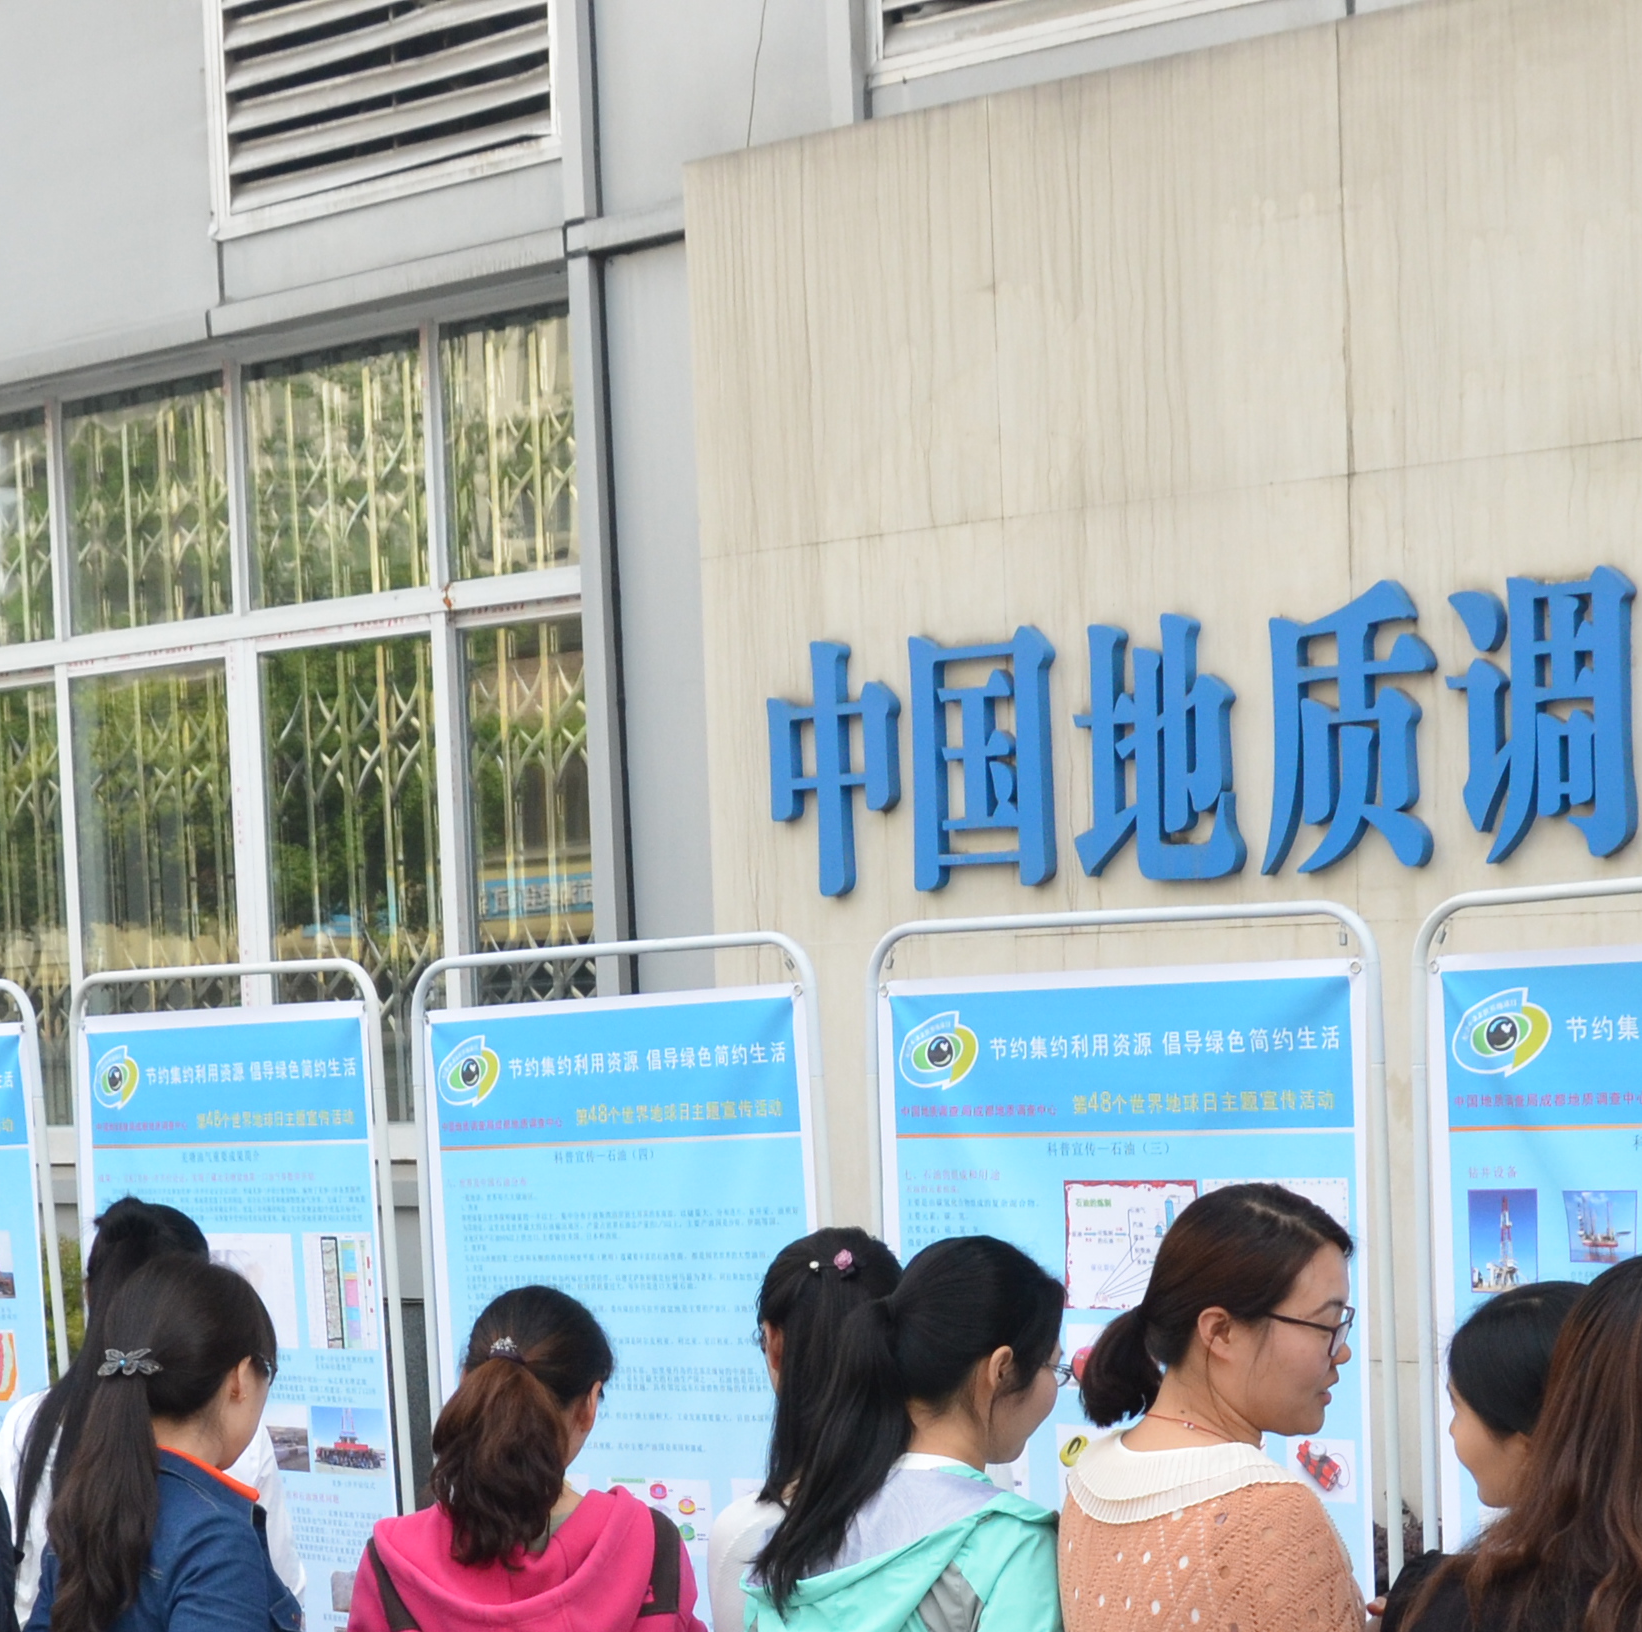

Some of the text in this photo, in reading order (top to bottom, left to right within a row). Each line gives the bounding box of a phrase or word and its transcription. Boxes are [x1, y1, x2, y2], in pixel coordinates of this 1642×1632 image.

[989, 1031, 1154, 1061] 节约集约利用资源
[1162, 1024, 1341, 1056] 倡导绿色简约生活
[145, 1057, 357, 1086] 节约集约利用资源 倡导绿色简约生活
[508, 1040, 787, 1080] 节约集约利用资源 倡导绿色简约生活
[575, 1098, 784, 1127] 第48个世界地球日主题宣传活动
[1072, 1089, 1336, 1116] 第48个世界地球日主题宣传活动
[196, 1108, 356, 1130] 第48个世界地球日主题宣传活动
